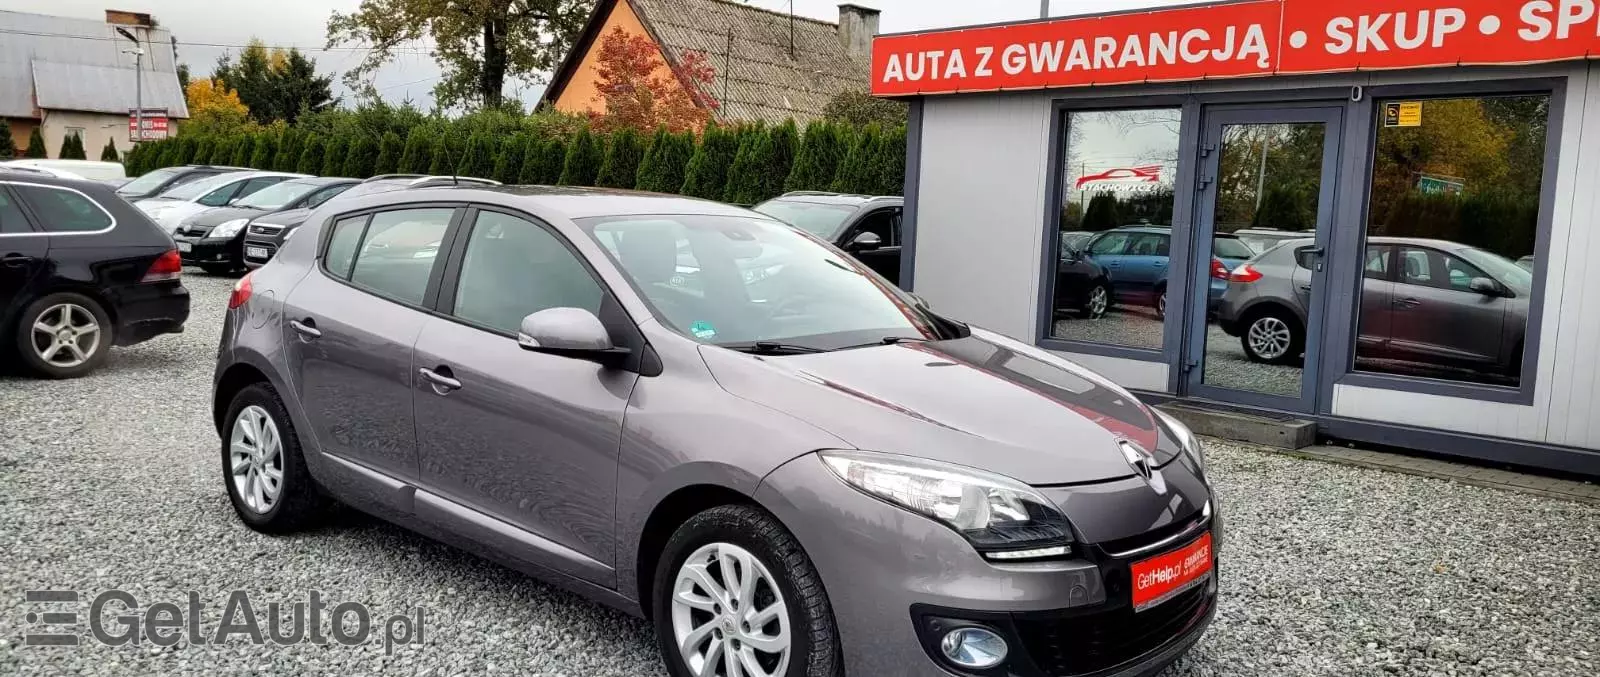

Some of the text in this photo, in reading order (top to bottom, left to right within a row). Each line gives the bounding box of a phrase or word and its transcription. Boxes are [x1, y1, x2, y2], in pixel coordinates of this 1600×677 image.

[882, 0, 1600, 83] AUTA Z GWARANCJĄ SKUP SP
[1137, 560, 1182, 590] GetHelp.pl
